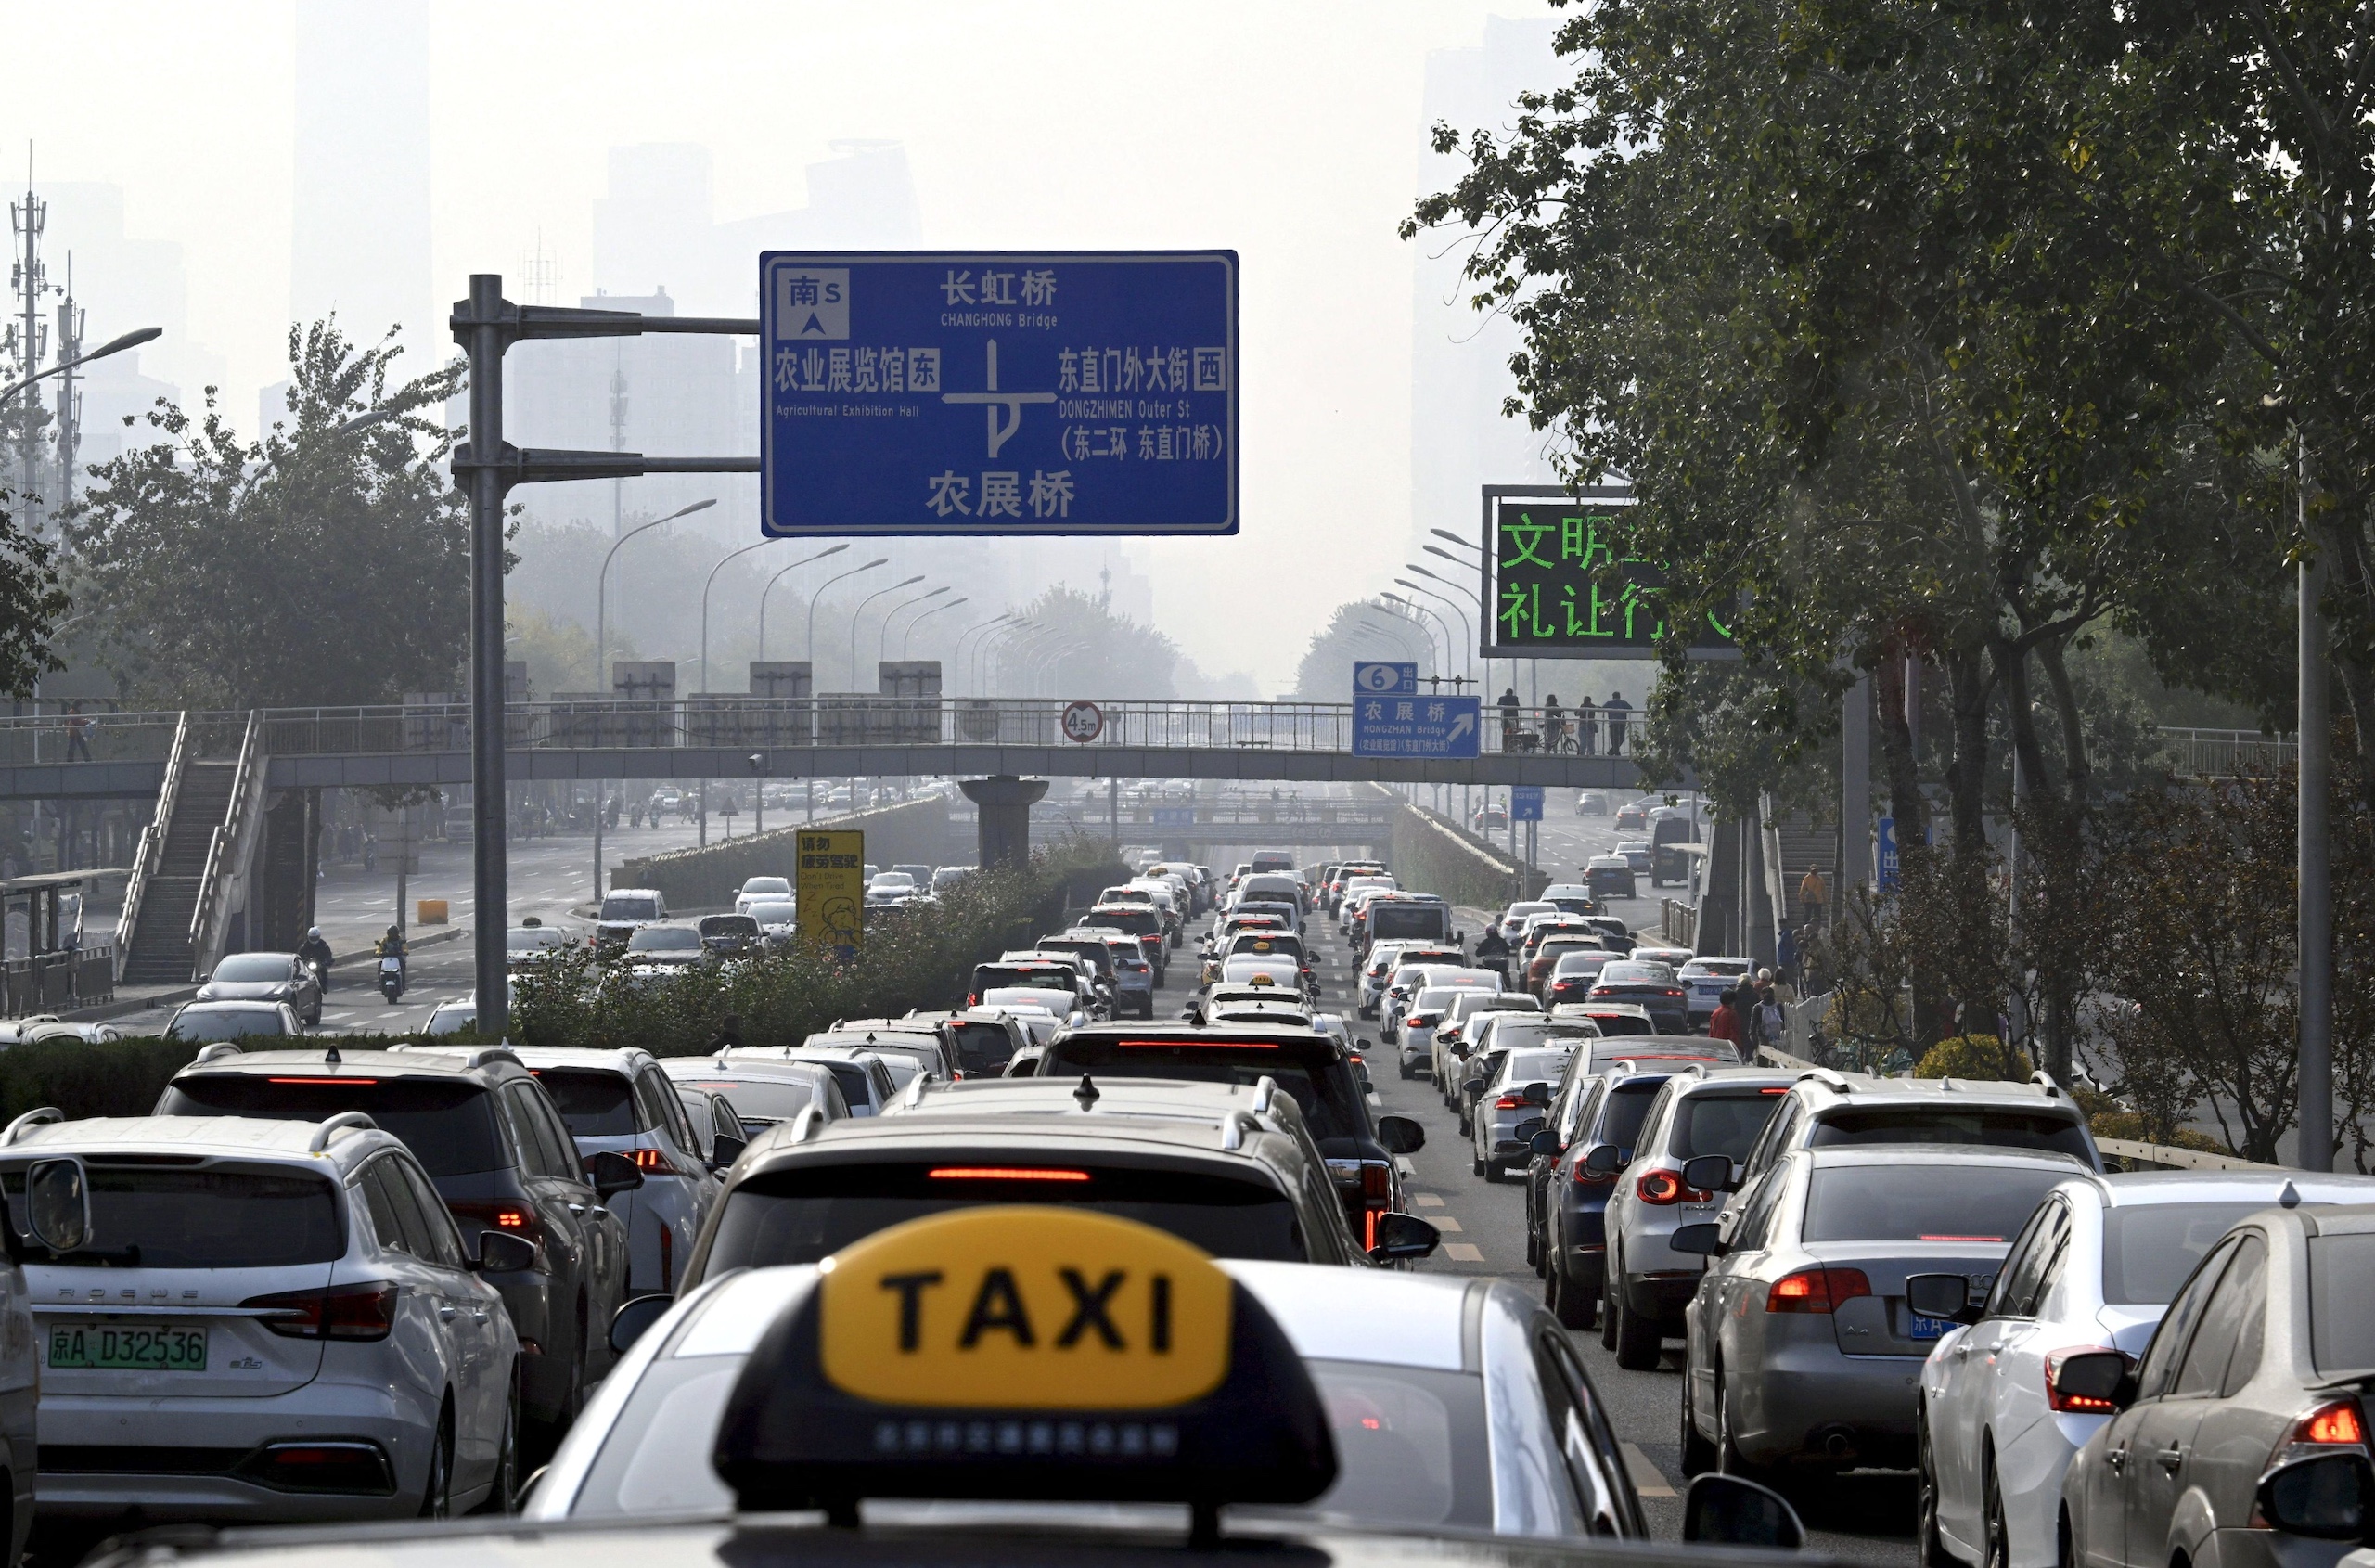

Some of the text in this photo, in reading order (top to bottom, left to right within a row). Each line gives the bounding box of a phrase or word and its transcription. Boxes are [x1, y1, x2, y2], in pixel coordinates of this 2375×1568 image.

[940, 269, 1058, 307] 长虹桥
[941, 313, 1058, 329] CHANGHONG Bridge
[775, 346, 937, 393] 农业展览馆 东
[1058, 346, 1221, 393] 东直门外大街 西
[776, 405, 919, 418] Agricultural Exhibition Hall
[1059, 400, 1190, 418] DONGZHIMEN Outer St
[925, 470, 1076, 518] 农展桥
[1499, 582, 1732, 639] 礼让行
[1371, 668, 1385, 688] 6
[1403, 666, 1414, 690] 出口
[1067, 712, 1097, 731] 4.5m
[1364, 701, 1445, 722] 农展桥
[1363, 725, 1446, 736] NONGZHAN Bridge
[802, 837, 830, 851] 请勿
[801, 854, 858, 868] 疲劳驾驶
[58, 1289, 198, 1298] ROEWE
[879, 1267, 1173, 1354] TAXI
